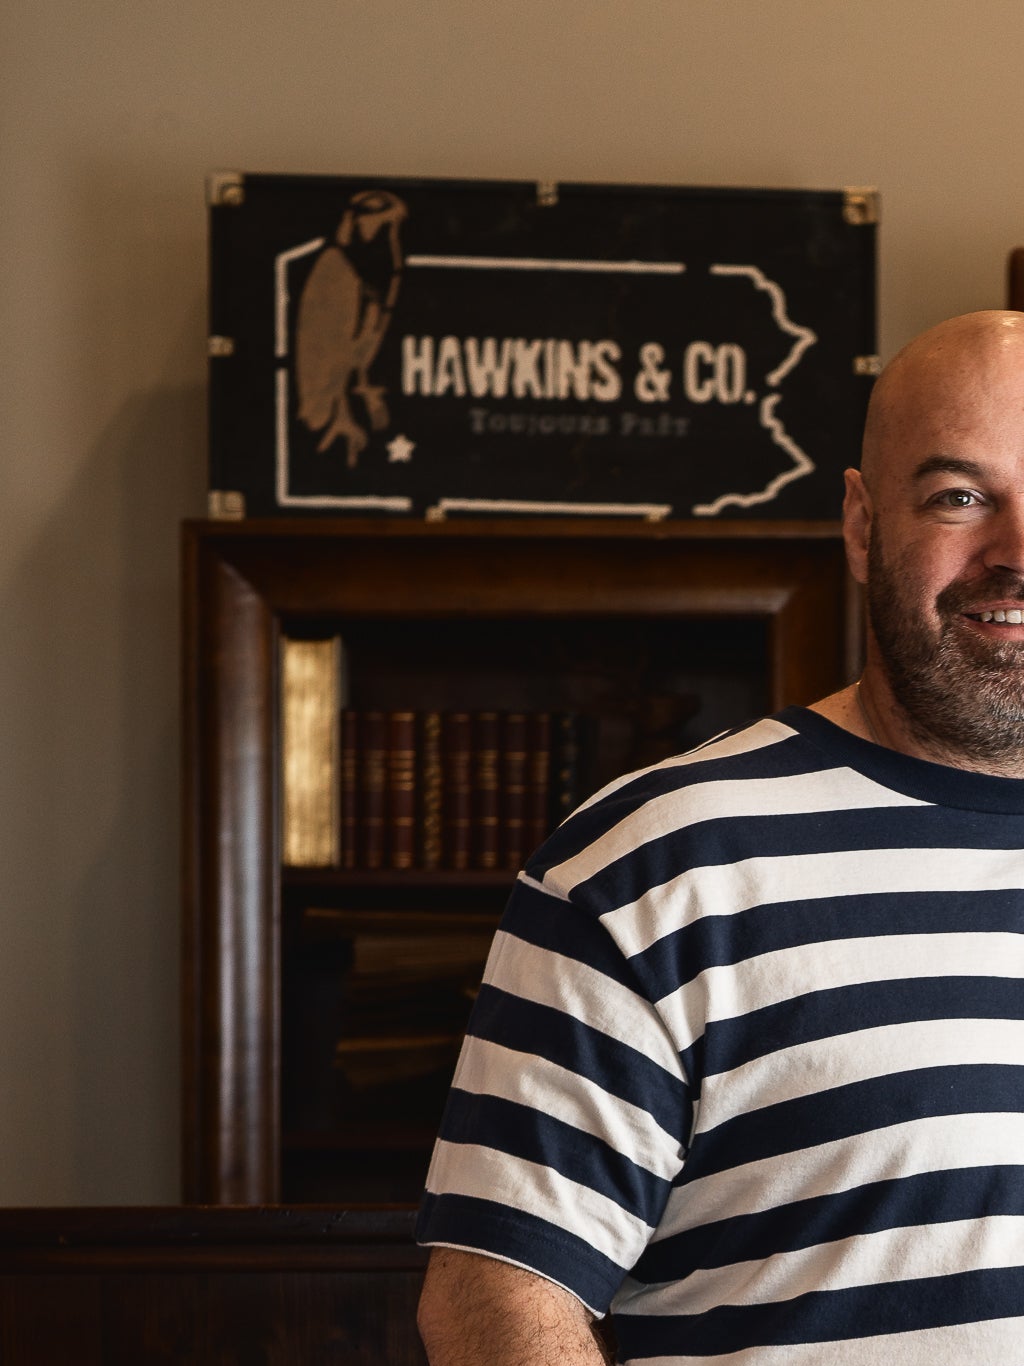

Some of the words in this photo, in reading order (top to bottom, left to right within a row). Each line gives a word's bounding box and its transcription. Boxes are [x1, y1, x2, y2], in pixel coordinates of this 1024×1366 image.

[402, 336, 621, 401] HAWKINS
[635, 343, 671, 402] &
[684, 341, 756, 405] CO.
